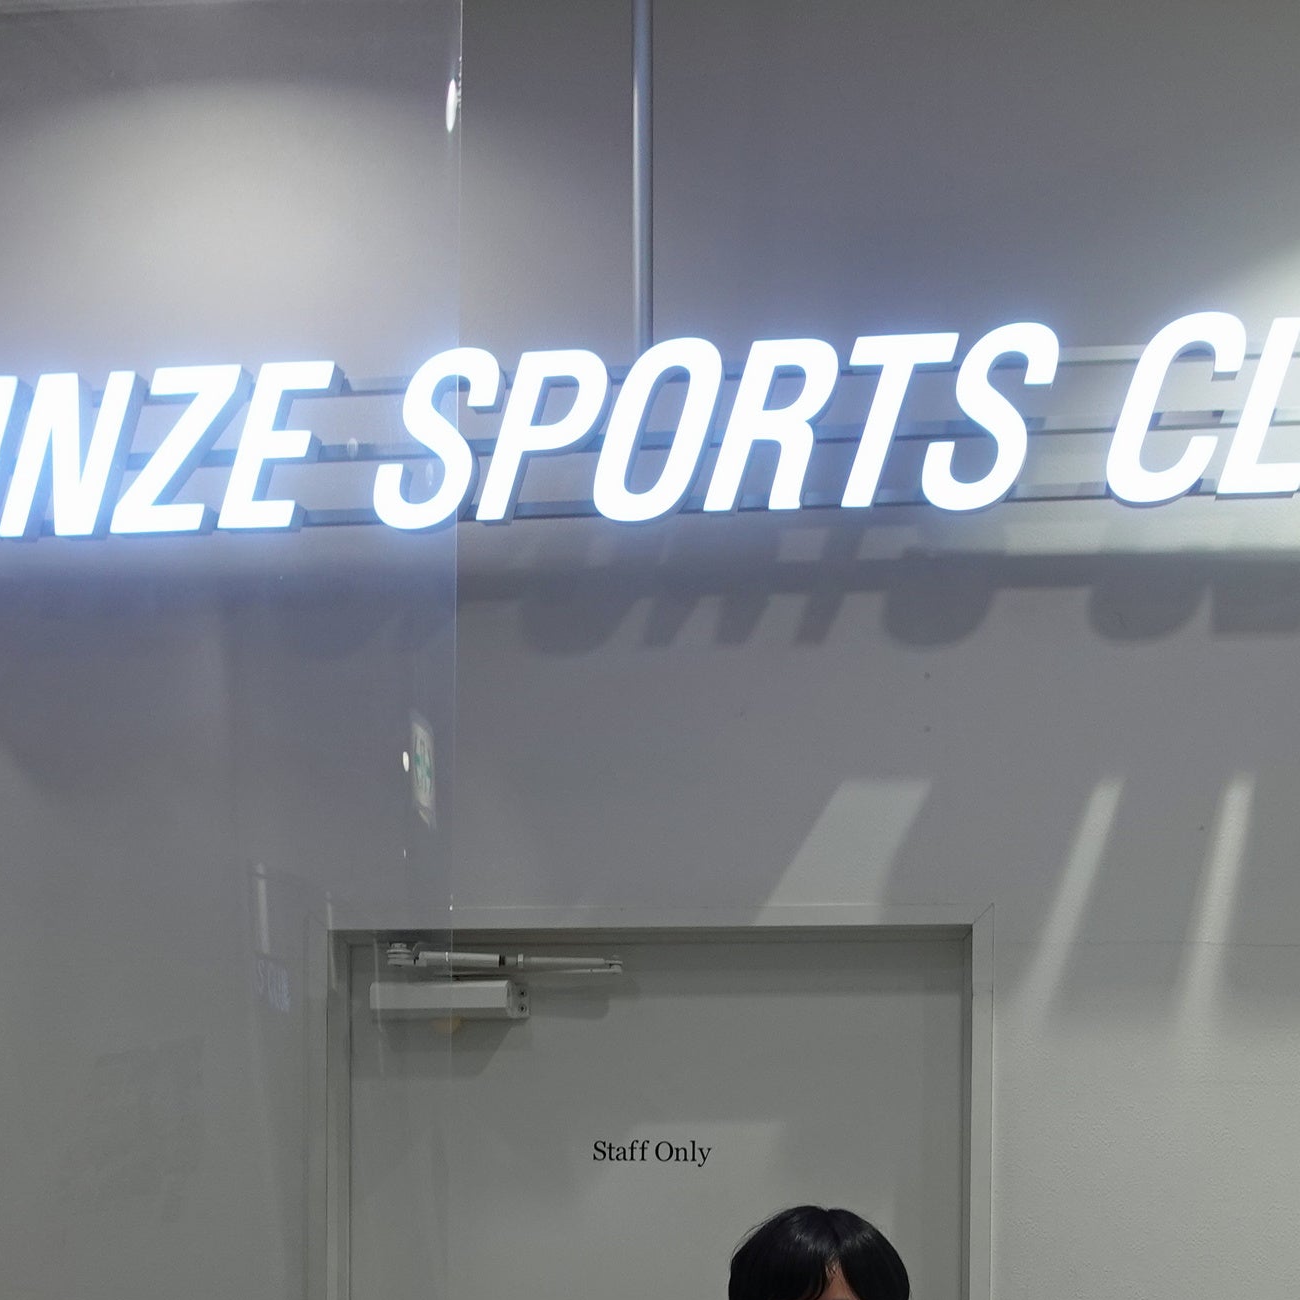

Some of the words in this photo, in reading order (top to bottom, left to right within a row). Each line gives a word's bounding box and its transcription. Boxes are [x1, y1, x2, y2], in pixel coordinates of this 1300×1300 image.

[372, 322, 1062, 530] SPORTS
[592, 1139, 650, 1162] Staff
[654, 1139, 713, 1168] Only
